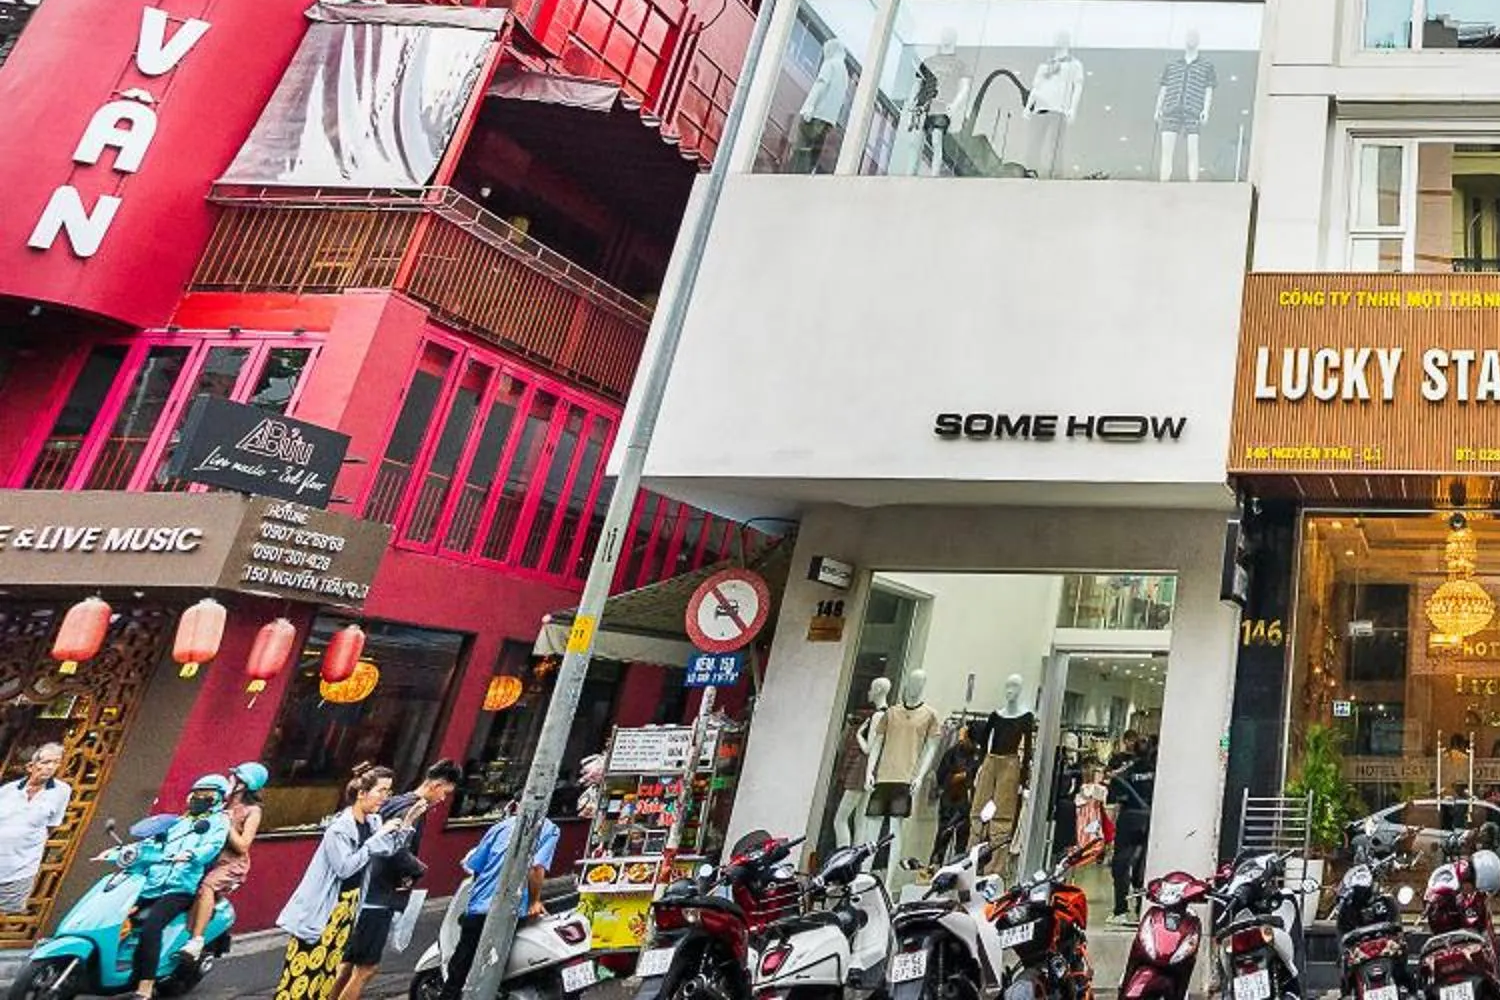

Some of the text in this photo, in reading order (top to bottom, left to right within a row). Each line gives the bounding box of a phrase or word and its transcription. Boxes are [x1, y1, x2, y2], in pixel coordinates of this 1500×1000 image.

[27, 5, 212, 259] VÂN
[1279, 287, 1325, 308] CÔNG
[1328, 290, 1351, 307] TY
[1355, 290, 1401, 308] TNHH
[1406, 288, 1443, 309] MỘT
[1254, 345, 1403, 402] LUCKY
[934, 413, 1187, 441] SOME HOW
[13, 529, 34, 548] &
[35, 526, 102, 551] LIVE
[103, 527, 203, 552] MUSIC
[1241, 617, 1284, 648] 146
